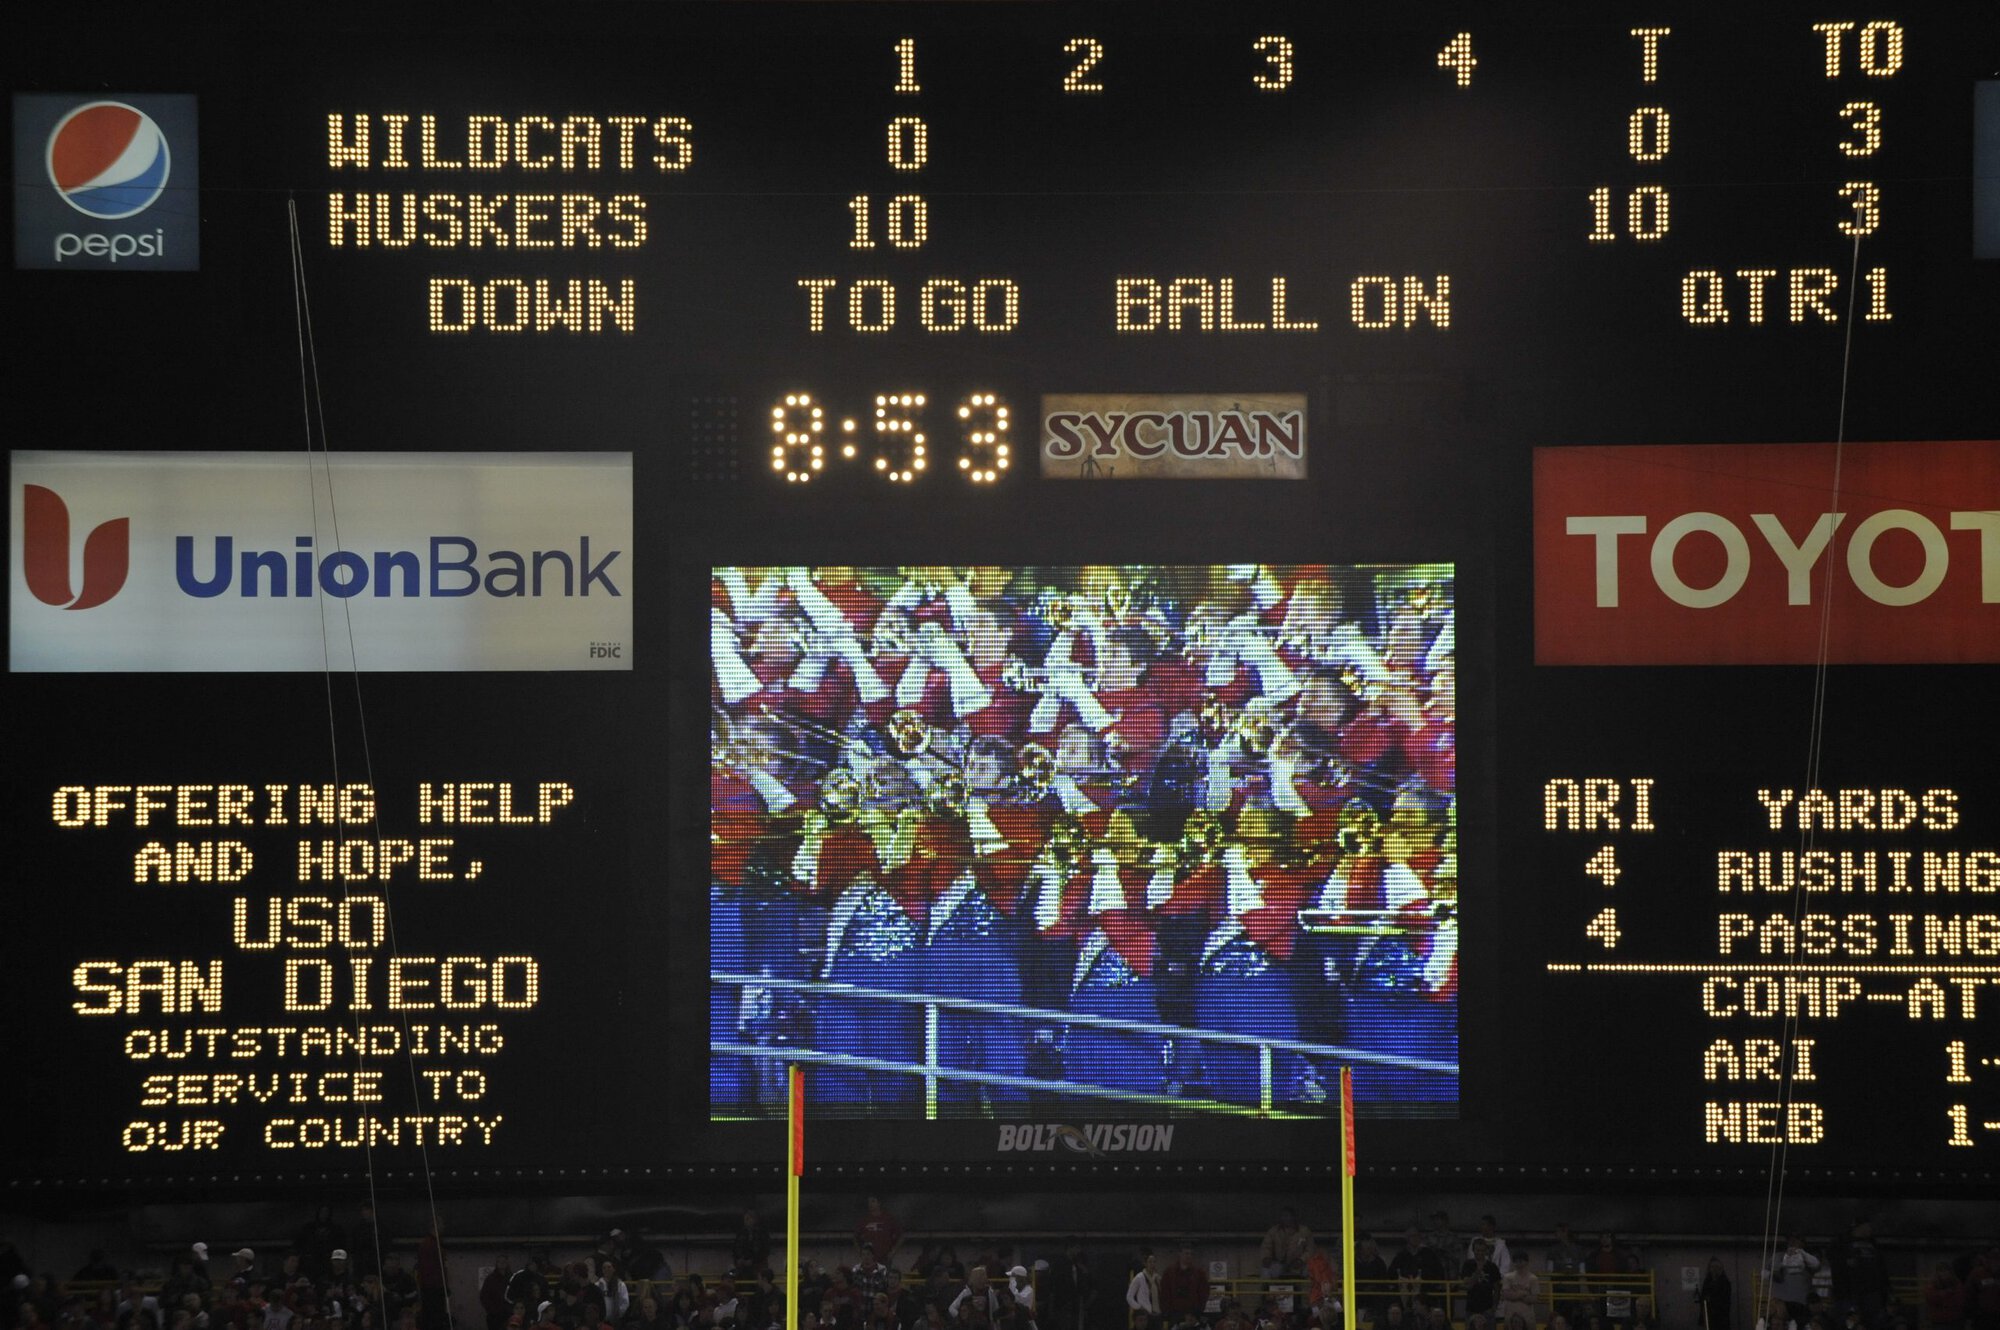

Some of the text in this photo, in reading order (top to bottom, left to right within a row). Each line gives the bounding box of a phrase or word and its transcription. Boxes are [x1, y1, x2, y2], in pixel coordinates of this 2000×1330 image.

[894, 21, 1903, 92] 1 2 3 4 T TO
[328, 102, 1881, 171] WILDCATS 0 0 3
[329, 182, 1879, 248] HUSKERS 10 10 3
[54, 228, 164, 262] pepsi
[429, 278, 635, 332] DOWN
[797, 279, 1019, 332] TO GO
[1116, 275, 1450, 331] BALL ON
[1682, 267, 1892, 324] QTR 1
[1046, 411, 1303, 459] SYCUAN
[590, 647, 621, 658] FDIC
[52, 782, 574, 827] OFFERING HELP
[1544, 778, 1959, 830] ARI YARDS
[134, 839, 483, 883] AND HOPE,
[1585, 845, 2000, 893] 4 RUSHING
[233, 895, 386, 949] USO
[1586, 907, 2000, 956] 4 PASSING
[72, 956, 539, 1015] SAN DIEGO
[1702, 976, 2000, 1019] COMP-AT
[125, 1024, 504, 1059] OUTSTANDING
[1704, 1039, 1816, 1081] ARI
[141, 1070, 486, 1106] SERVICE TO
[122, 1115, 503, 1152] OUR COUNTRY
[997, 1124, 1174, 1152] BOLT VISION
[1705, 1102, 1824, 1144] NEB
